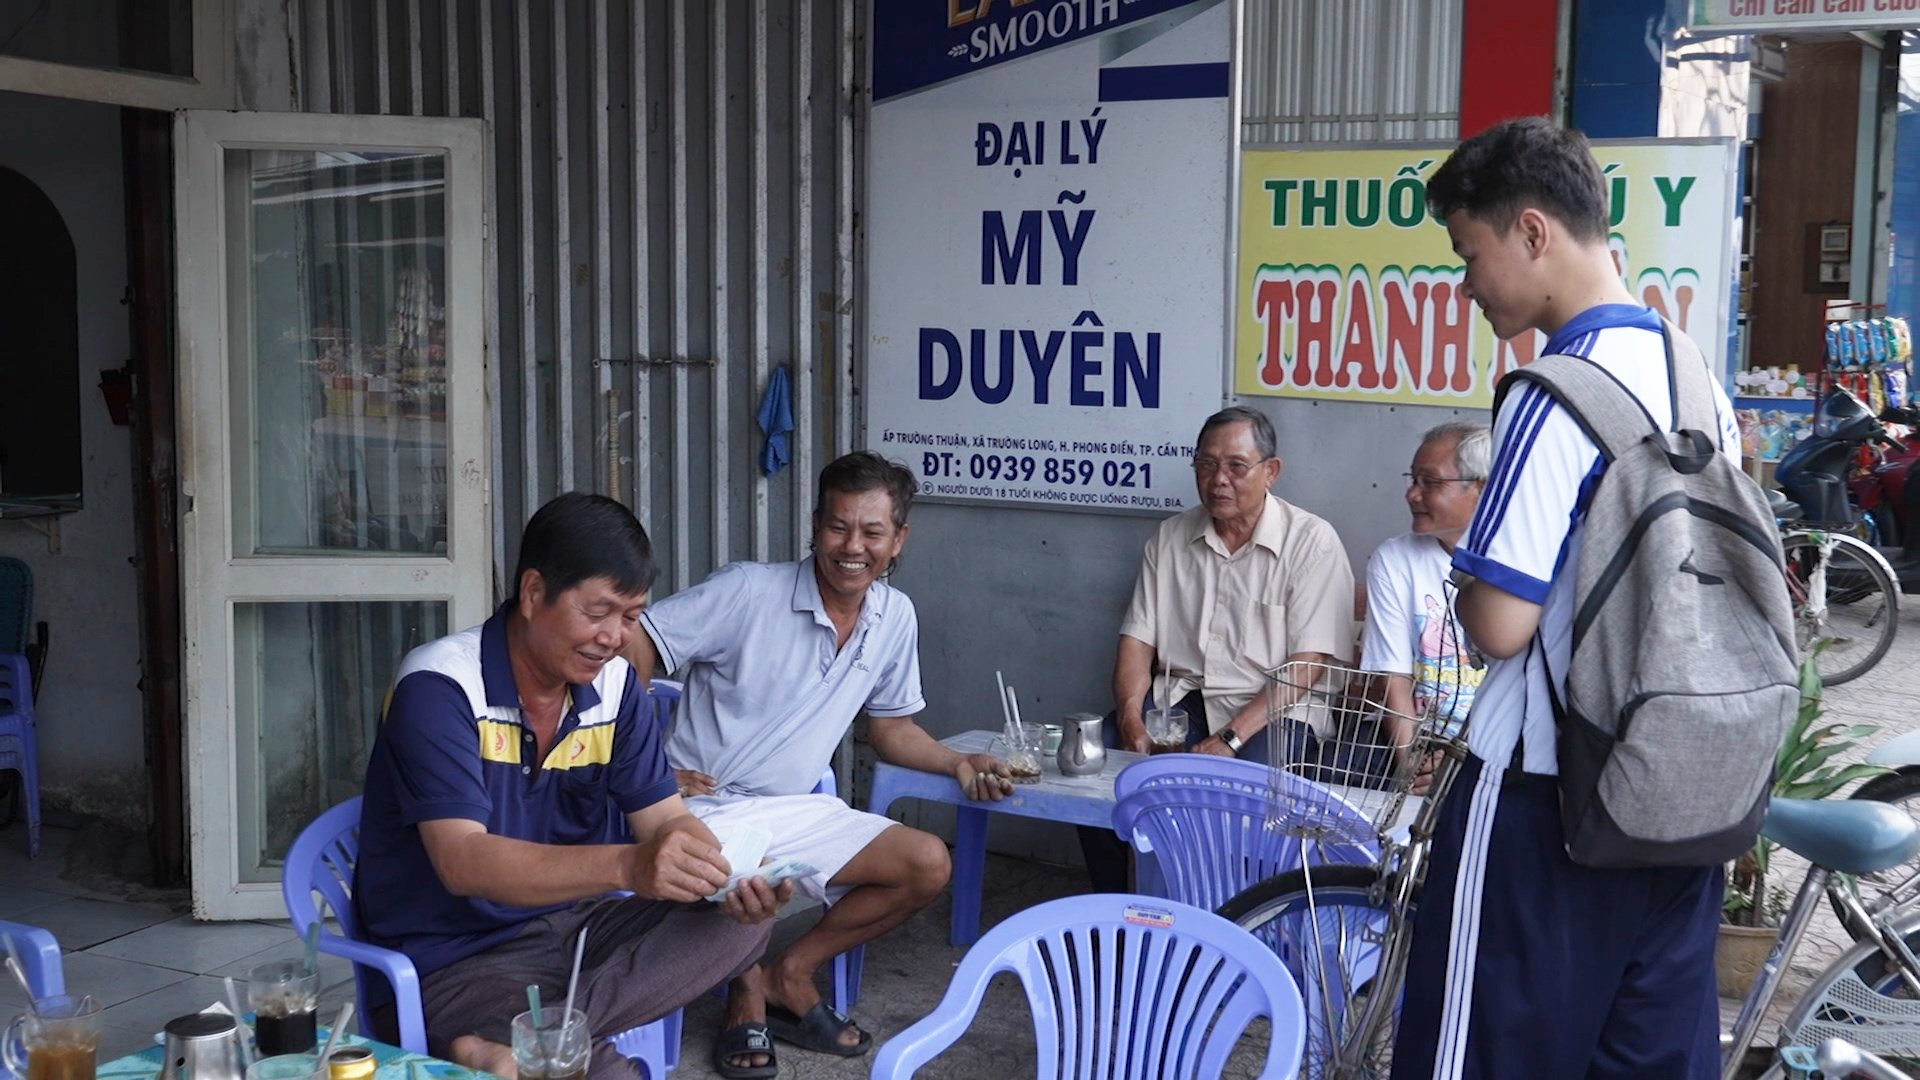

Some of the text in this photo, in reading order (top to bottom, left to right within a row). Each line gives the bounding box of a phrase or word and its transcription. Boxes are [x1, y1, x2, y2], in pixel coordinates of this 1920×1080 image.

[969, 0, 1119, 63] SMOOTH
[975, 107, 1107, 178] ĐẠI LÝ
[1264, 159, 1447, 228] THUỐ
[1654, 176, 1697, 227] Y
[981, 190, 1096, 286] MỸ
[918, 310, 1161, 409] DUYÊN
[1255, 268, 1474, 393] THANH
[922, 451, 1151, 488] ĐT: 0939 859 021
[972, 435, 985, 447] XÃ
[1028, 439, 1057, 452] LONG,
[1059, 441, 1070, 451] H.
[1073, 442, 1109, 454] PHONG
[1139, 444, 1154, 456] TP.
[995, 488, 1006, 498] 18
